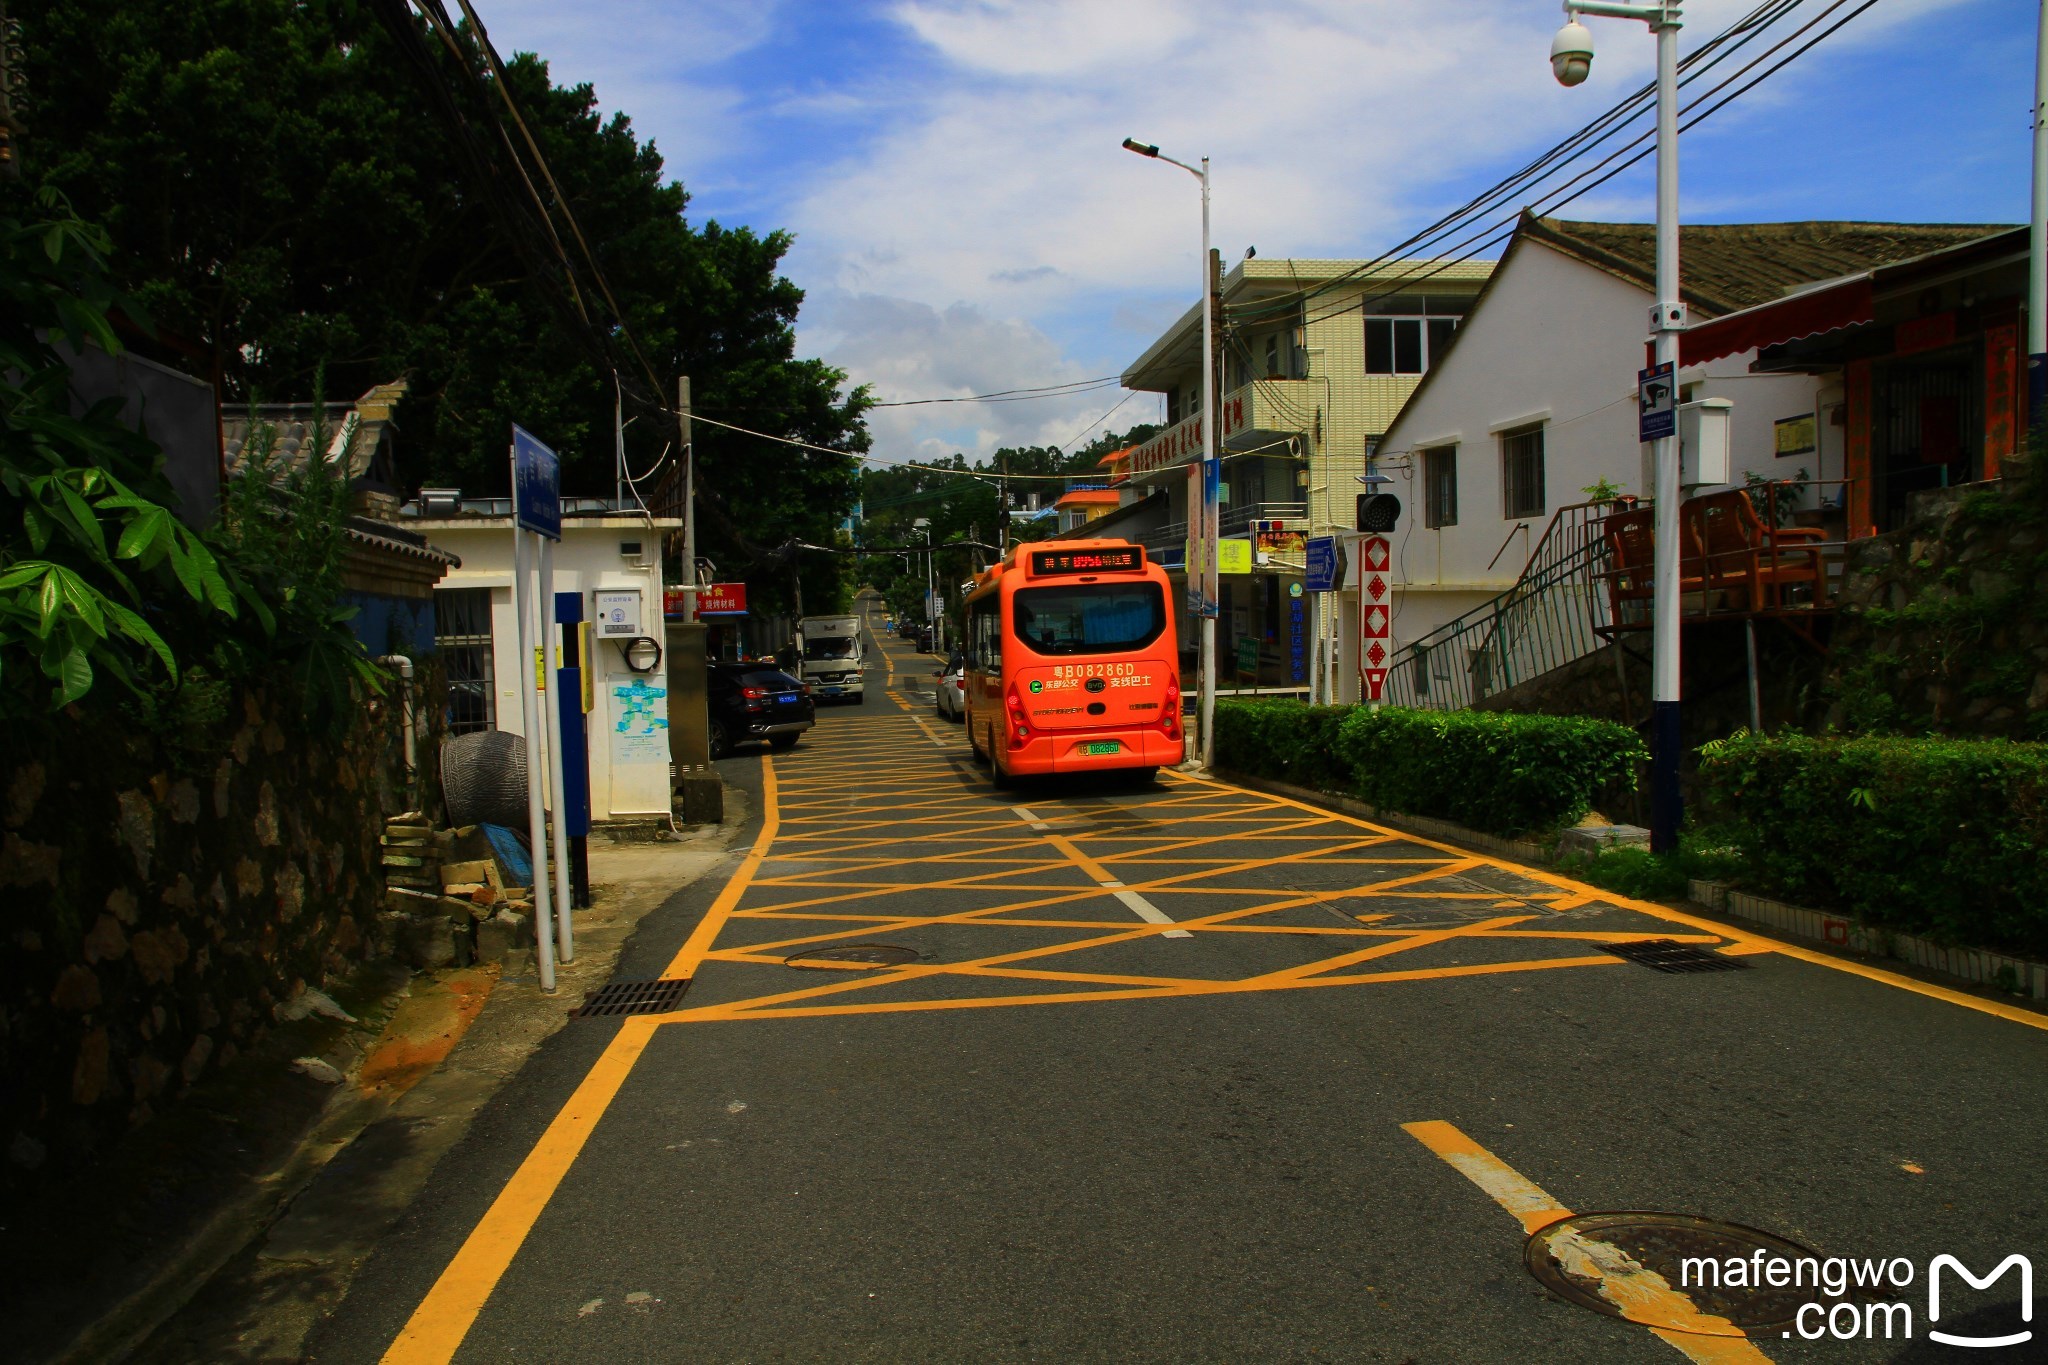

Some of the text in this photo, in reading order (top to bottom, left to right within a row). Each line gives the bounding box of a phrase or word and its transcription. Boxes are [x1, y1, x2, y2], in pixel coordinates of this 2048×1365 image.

[1053, 663, 1134, 678] 粤B08286D
[1110, 675, 1151, 688] 支线巴士
